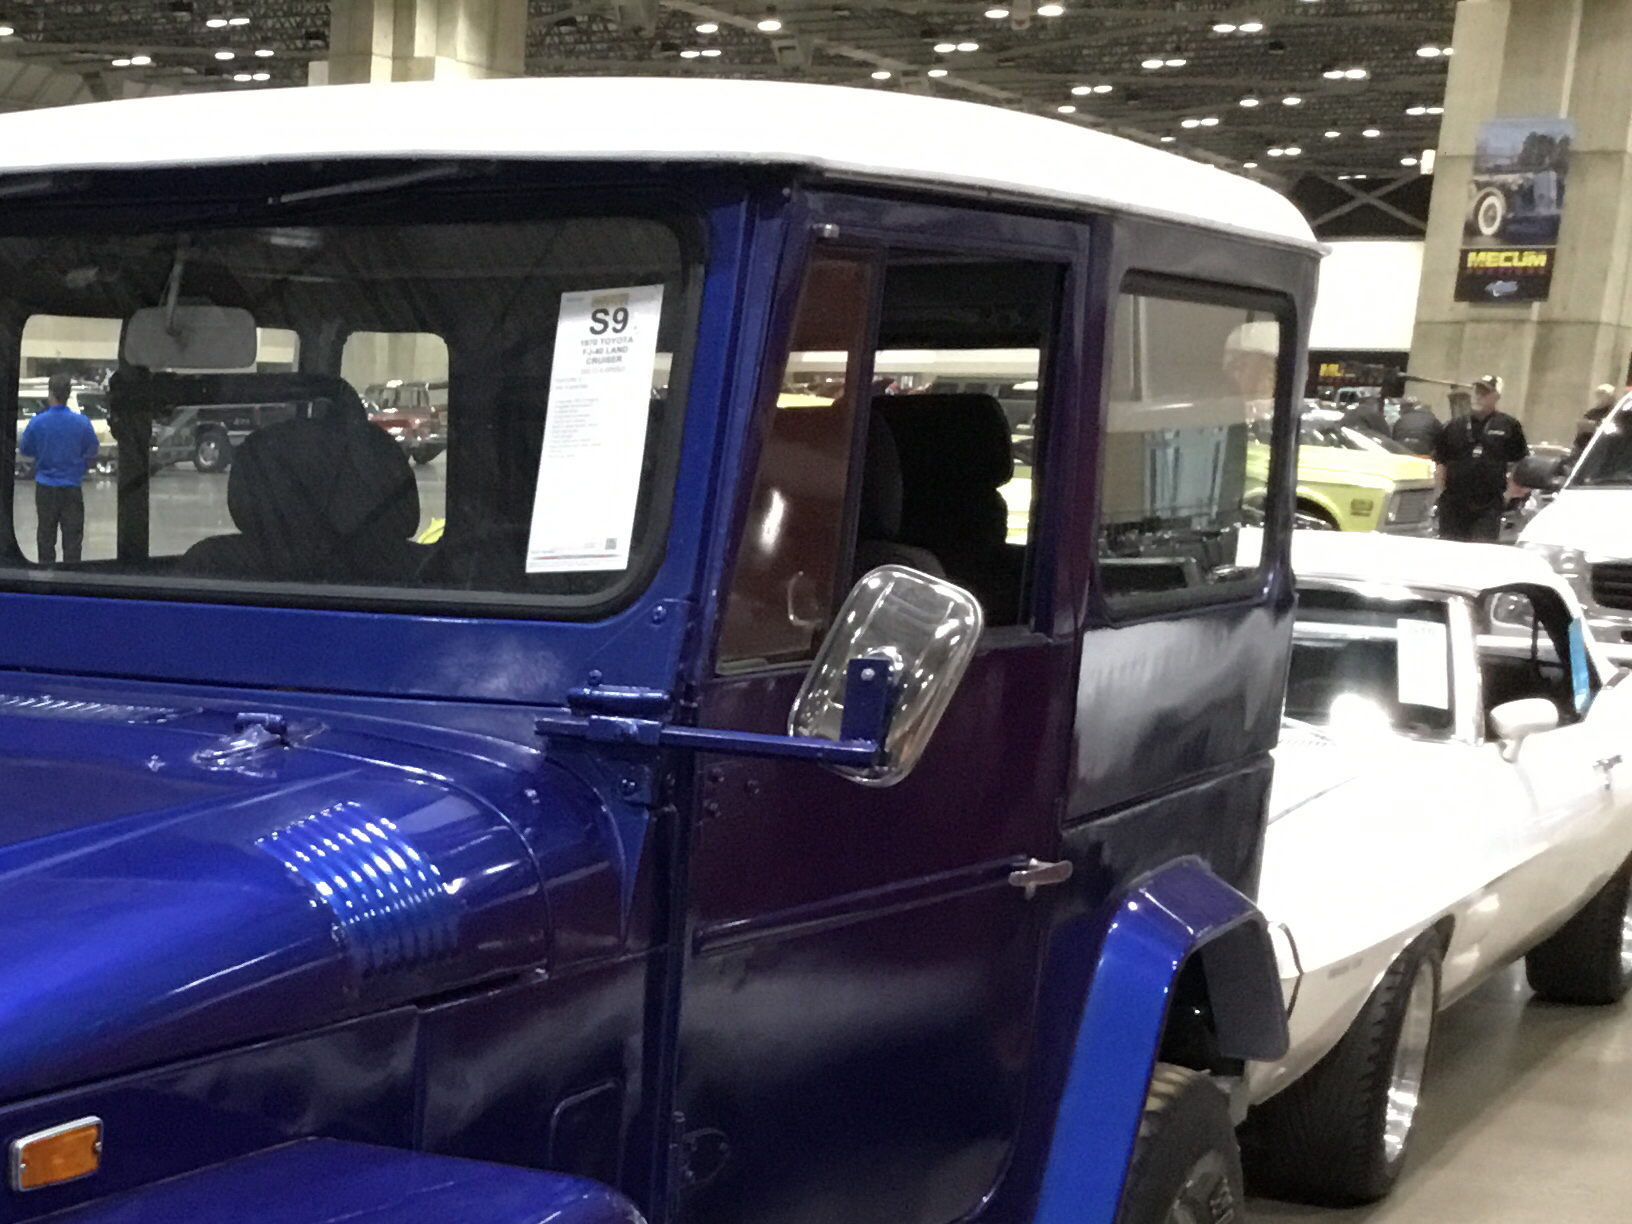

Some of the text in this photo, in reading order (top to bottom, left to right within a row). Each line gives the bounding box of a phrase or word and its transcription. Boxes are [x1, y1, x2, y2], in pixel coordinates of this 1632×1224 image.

[1467, 251, 1547, 268] MECUM
[589, 307, 629, 335] S9
[600, 336, 634, 345] TOYOTA
[605, 346, 629, 354] LAND
[585, 355, 622, 365] CRUISER
